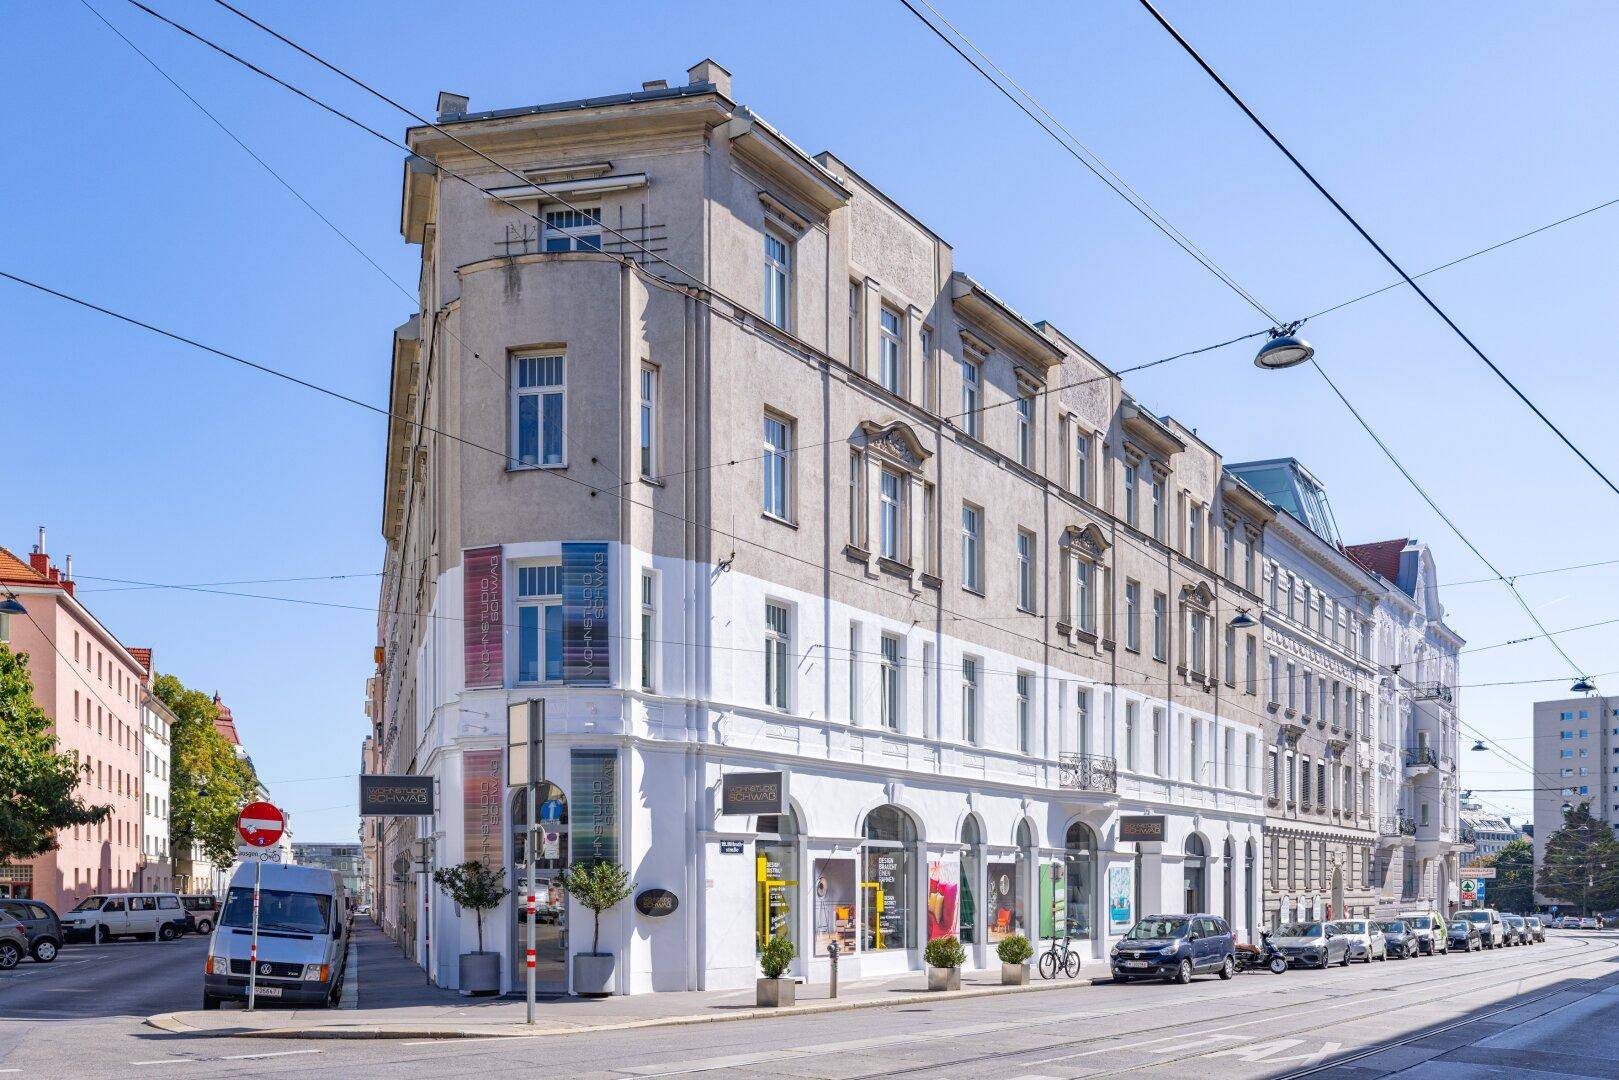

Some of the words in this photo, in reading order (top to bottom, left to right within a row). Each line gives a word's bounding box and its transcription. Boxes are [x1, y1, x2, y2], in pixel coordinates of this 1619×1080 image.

[490, 556, 499, 621] SCHWAB
[594, 552, 604, 619] SCHWAB
[481, 578, 490, 679] WOHNSTUDIO
[583, 573, 593, 676] WOHNSTUDIO
[368, 795, 428, 803] SCHWAB
[481, 782, 491, 867] OHNSTUDIO
[490, 760, 500, 825] SCHWAB
[603, 759, 615, 825] SCHWAB
[729, 793, 777, 802] SCHWAB
